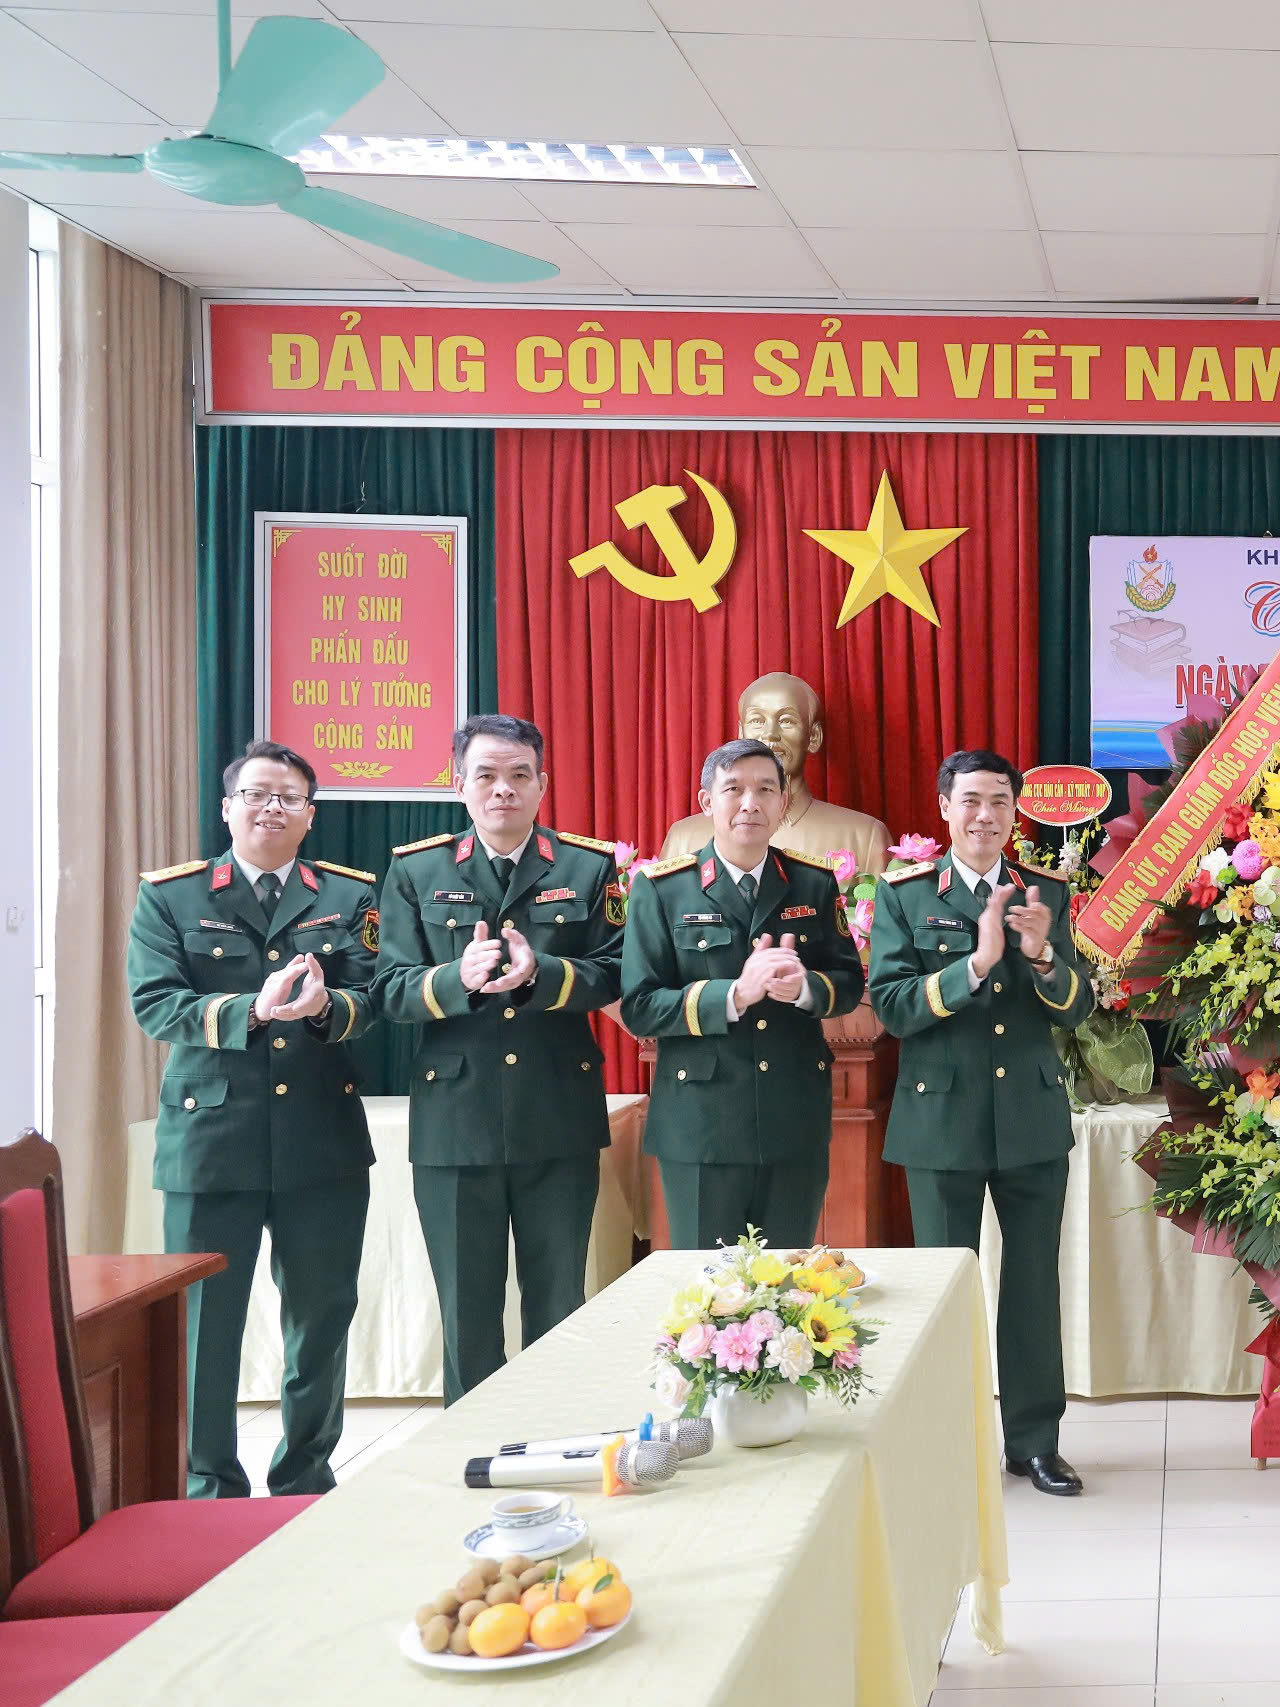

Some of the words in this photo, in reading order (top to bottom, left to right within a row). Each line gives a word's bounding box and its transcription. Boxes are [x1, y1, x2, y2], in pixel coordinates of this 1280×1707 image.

[268, 311, 486, 393] ĐẢNG
[516, 322, 725, 409] CỘNG
[754, 317, 919, 399] SẢN
[944, 329, 1102, 414] VIỆT
[318, 543, 365, 578] SUỐT
[377, 548, 408, 579] ĐỜI
[322, 595, 345, 621] HY
[358, 596, 402, 622] SINH
[311, 629, 361, 664] PHẤN
[373, 631, 409, 665] ĐẤU
[292, 679, 329, 706] CHO
[340, 676, 361, 706] LÝ
[372, 672, 432, 708] TƯỞNG
[313, 718, 364, 754] CỘNG
[376, 715, 414, 750] SẢN
[1031, 800, 1057, 813] Chúc
[1060, 800, 1099, 817] Mừng
[1100, 880, 1149, 933] ĐẢNG
[1128, 856, 1170, 888] ỦY,
[1152, 820, 1194, 865] BAN
[1179, 781, 1224, 830] GIÁM
[1208, 752, 1247, 791] ĐỐC
[1231, 720, 1270, 760] HỌC
